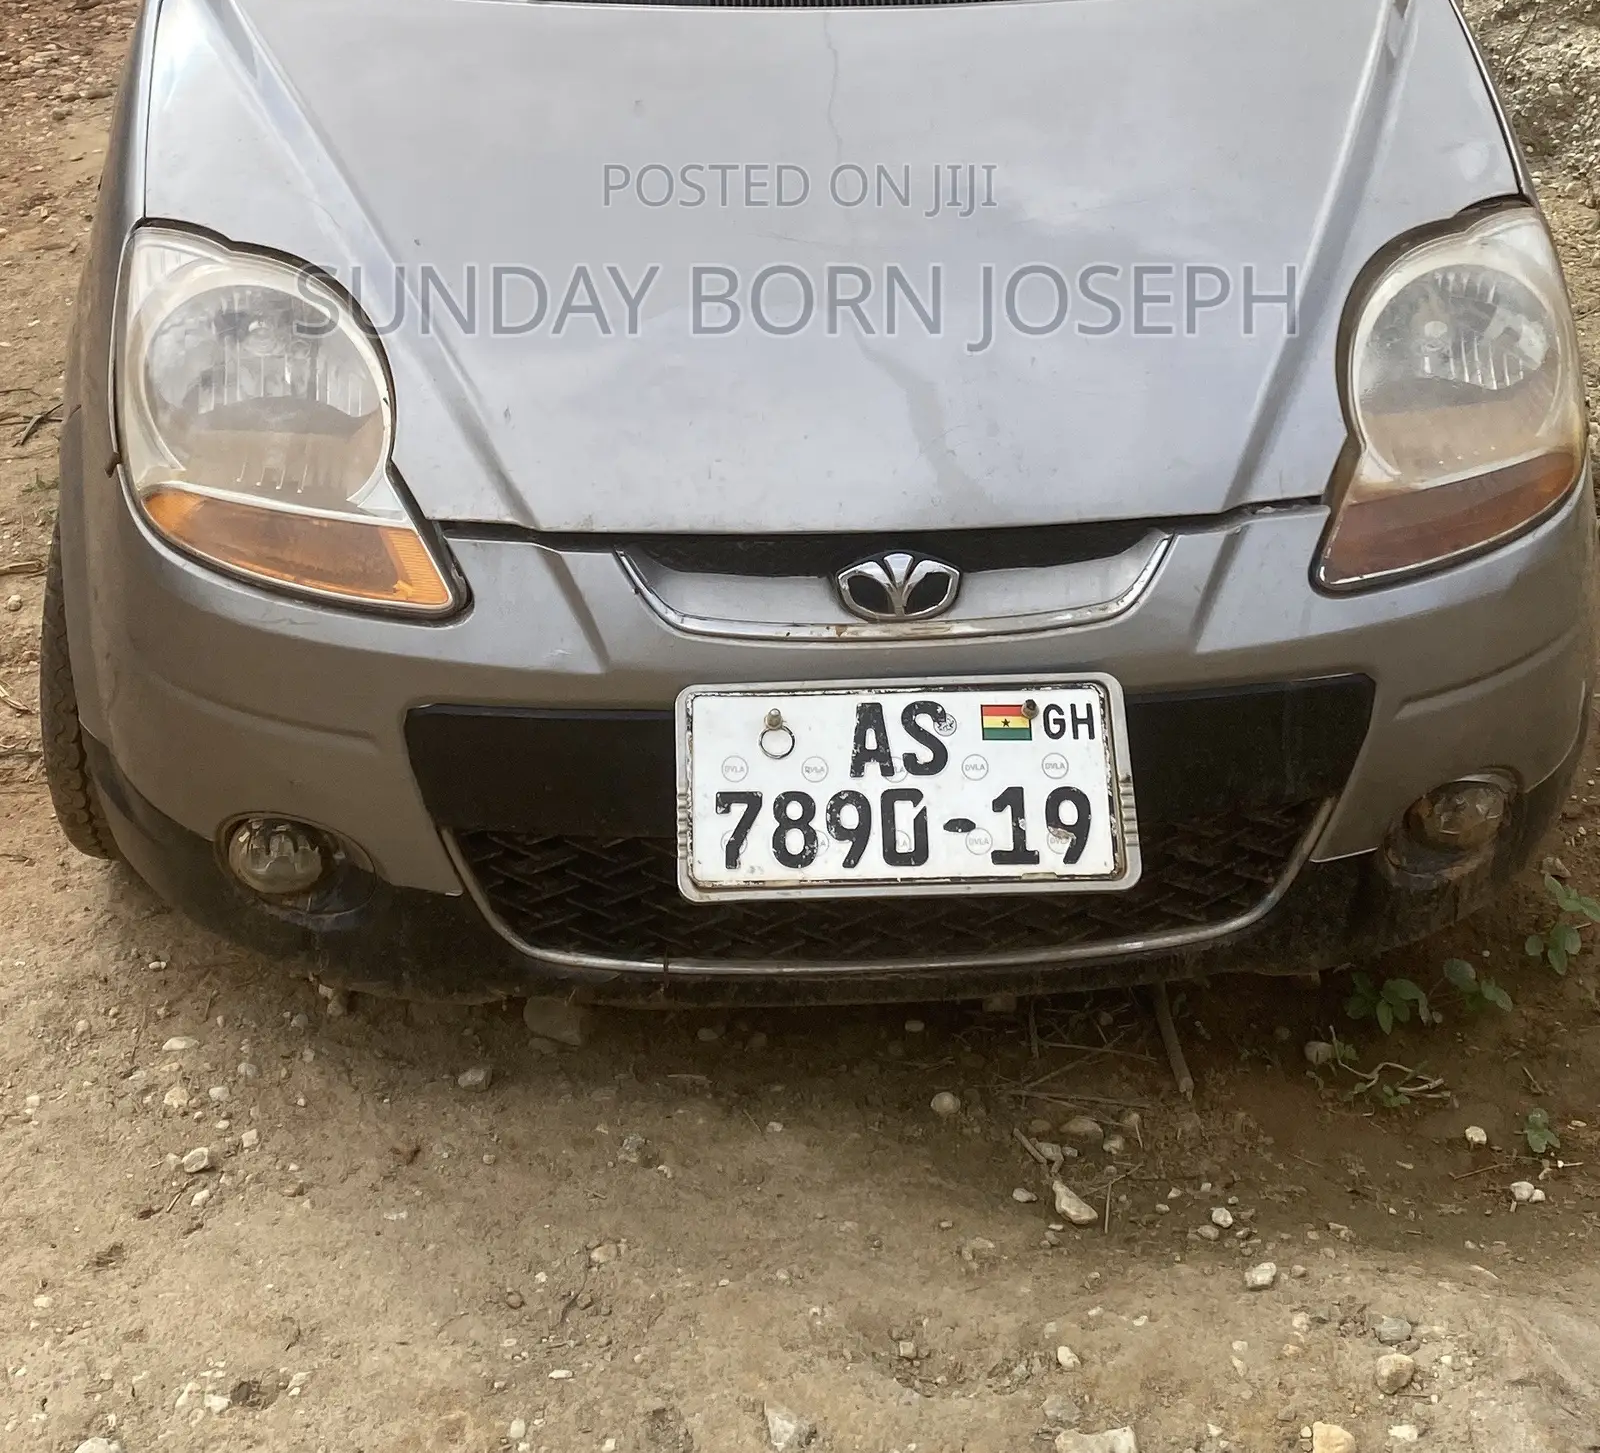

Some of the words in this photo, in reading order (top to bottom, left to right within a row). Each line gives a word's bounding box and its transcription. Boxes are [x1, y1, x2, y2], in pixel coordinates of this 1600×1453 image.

[1043, 703, 1095, 739] GH
[850, 701, 948, 777] AS
[964, 763, 986, 772] DVLA
[968, 837, 990, 846] DVLA
